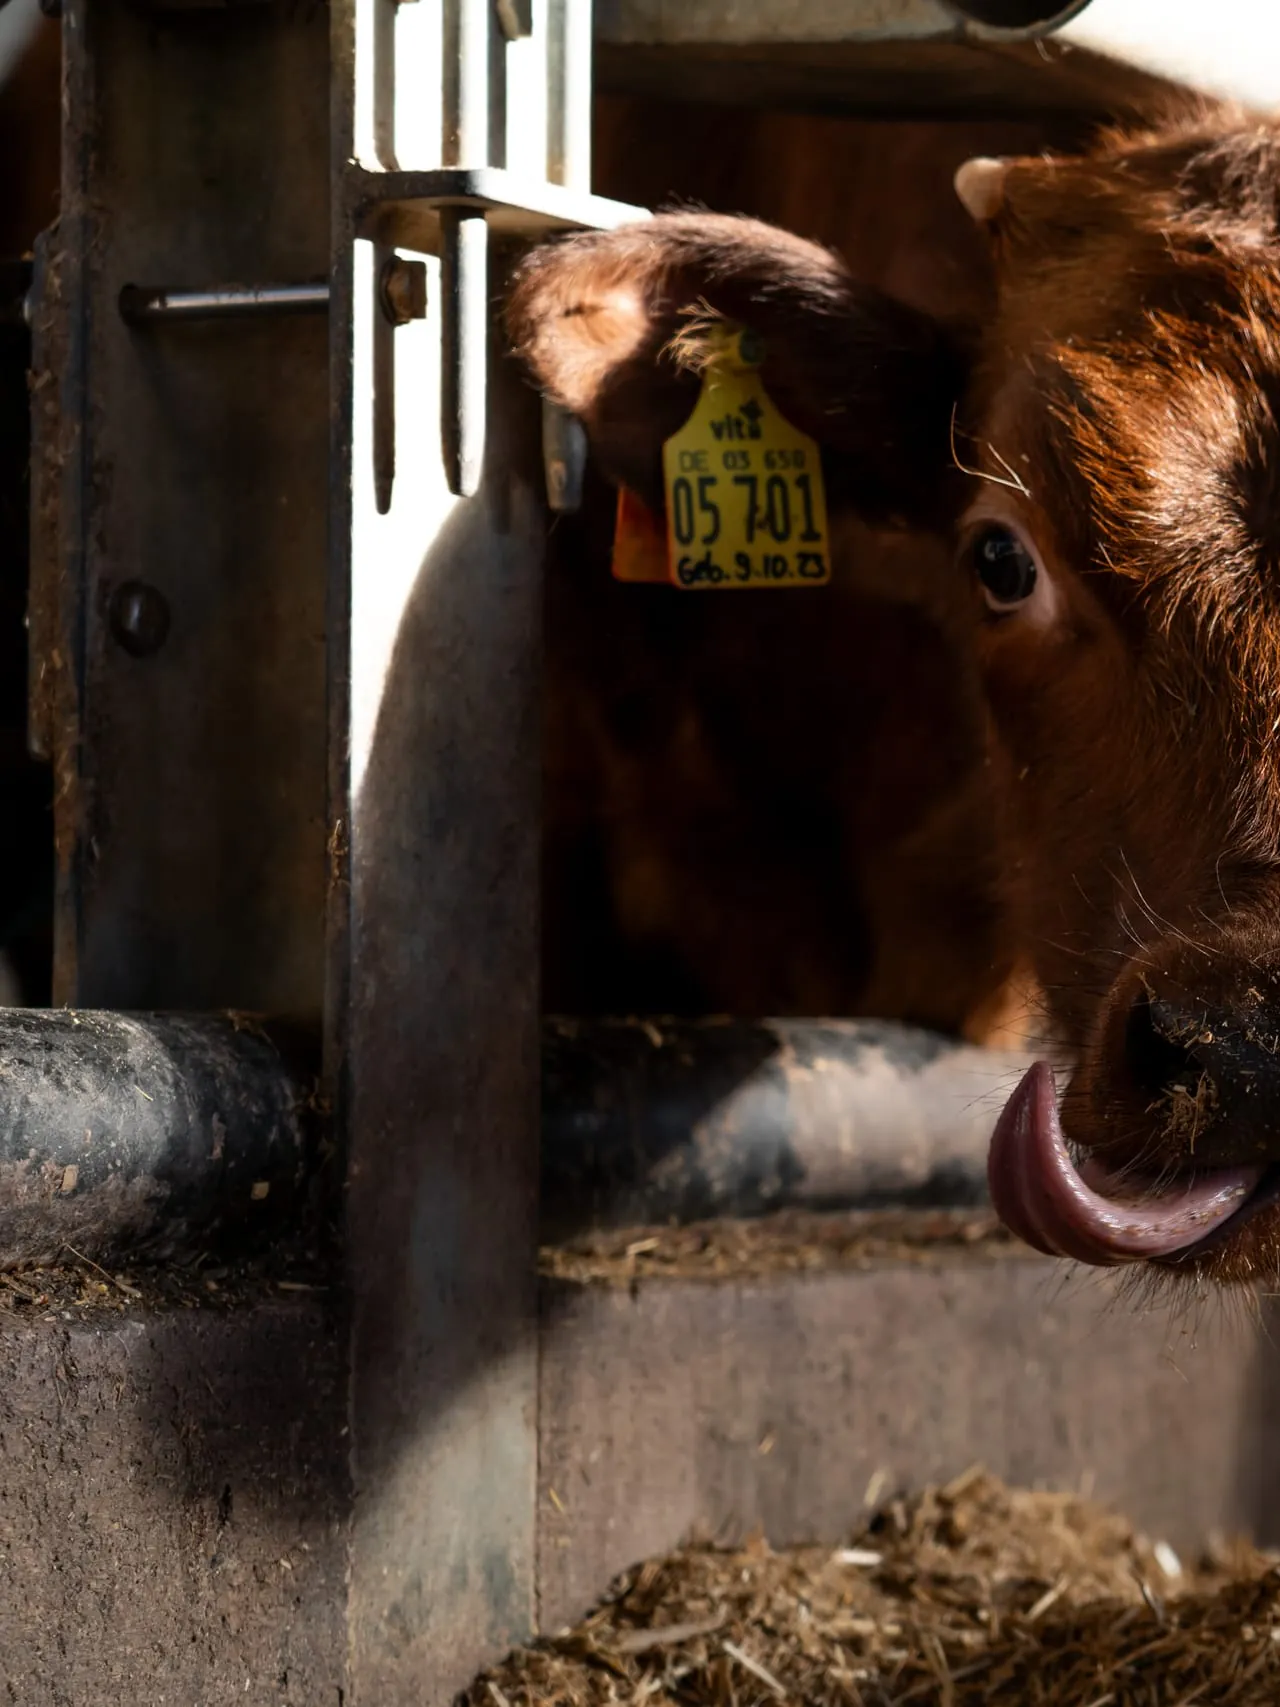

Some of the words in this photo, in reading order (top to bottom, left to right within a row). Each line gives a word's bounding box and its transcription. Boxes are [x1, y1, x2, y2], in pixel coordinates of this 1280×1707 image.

[679, 449, 709, 473] DE
[722, 449, 751, 471] 03
[763, 449, 806, 471] 650
[673, 475, 721, 546] 05
[732, 474, 822, 544] 701
